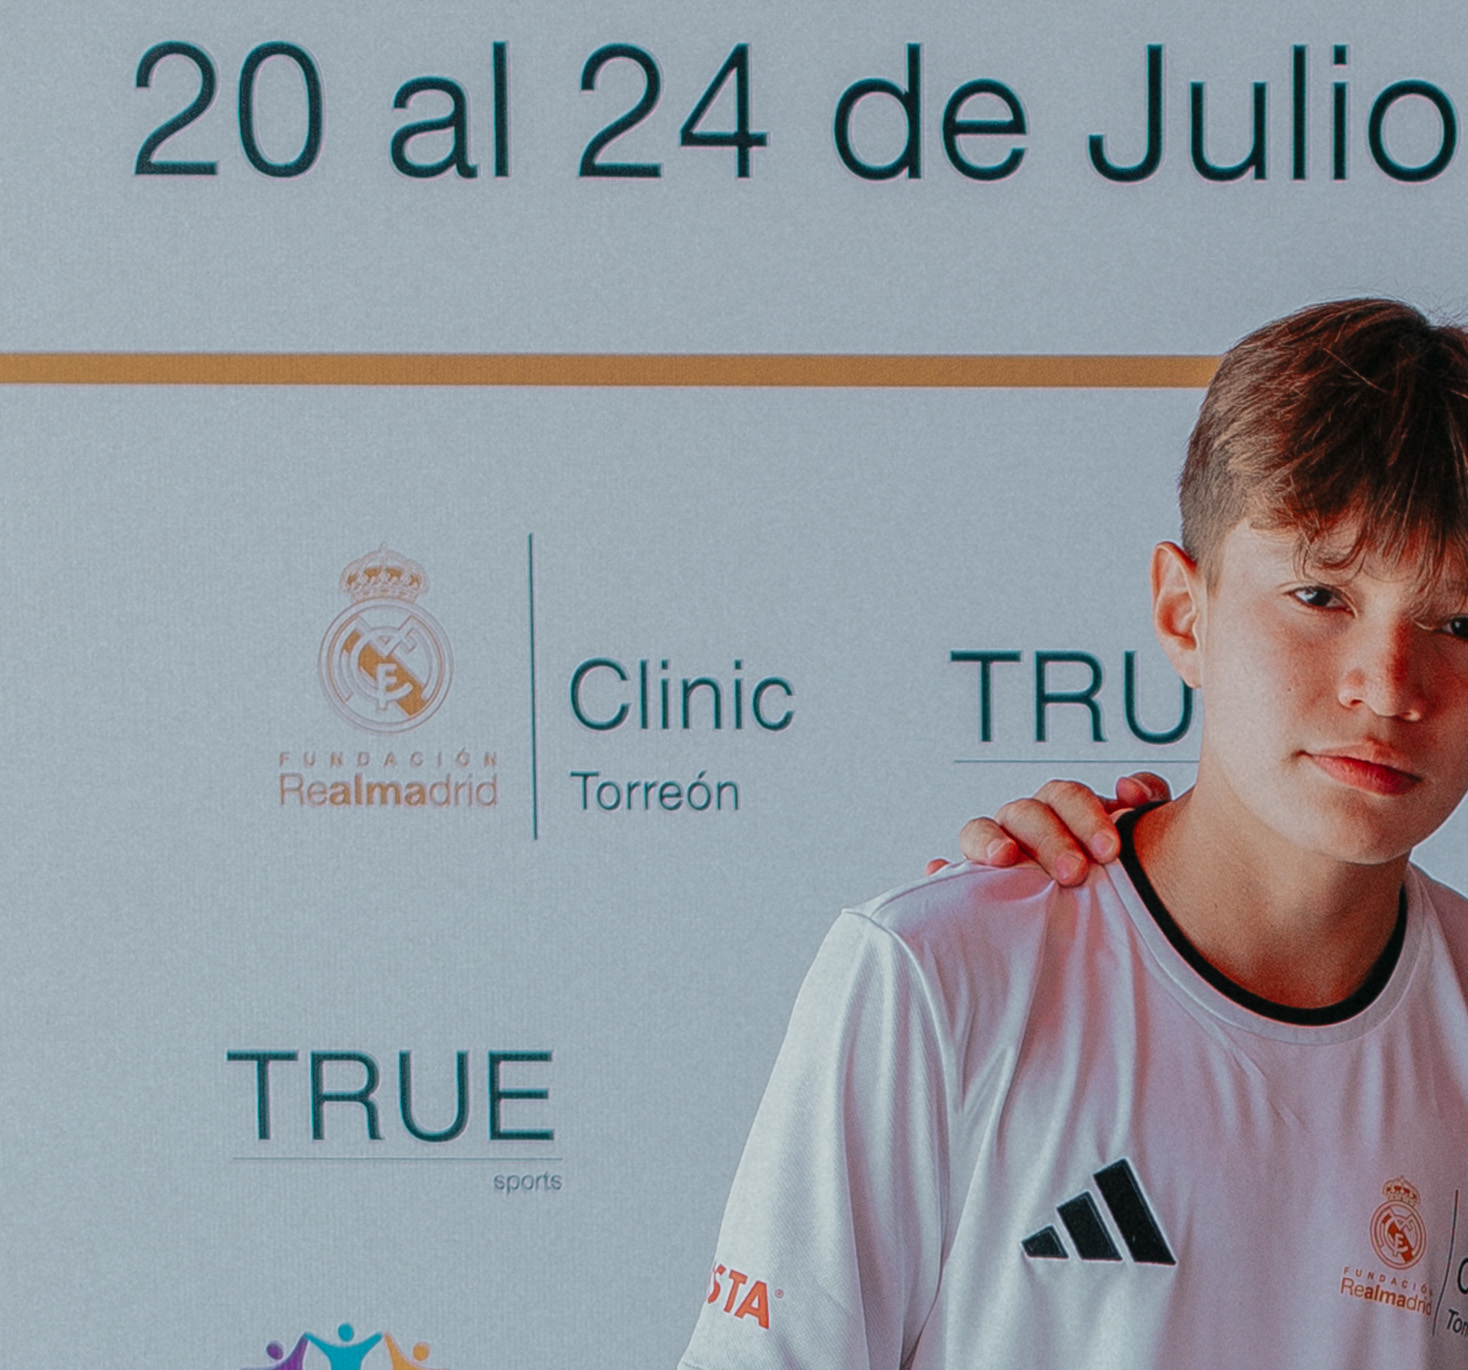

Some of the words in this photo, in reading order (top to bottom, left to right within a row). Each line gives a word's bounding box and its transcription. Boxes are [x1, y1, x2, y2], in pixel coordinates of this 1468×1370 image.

[134, 41, 323, 179] 20
[390, 42, 509, 180] al
[578, 44, 768, 179] 24
[834, 43, 1027, 182] de
[1088, 45, 1457, 183] Julio
[570, 658, 794, 732] Clinic
[950, 651, 1194, 746] TRU
[278, 747, 498, 768] FUNDACIÓN
[280, 774, 497, 807] Realmadrid
[569, 770, 739, 812] Torreón
[227, 1051, 555, 1143] TRUE
[493, 1172, 562, 1195] sports
[706, 1262, 770, 1331] STA
